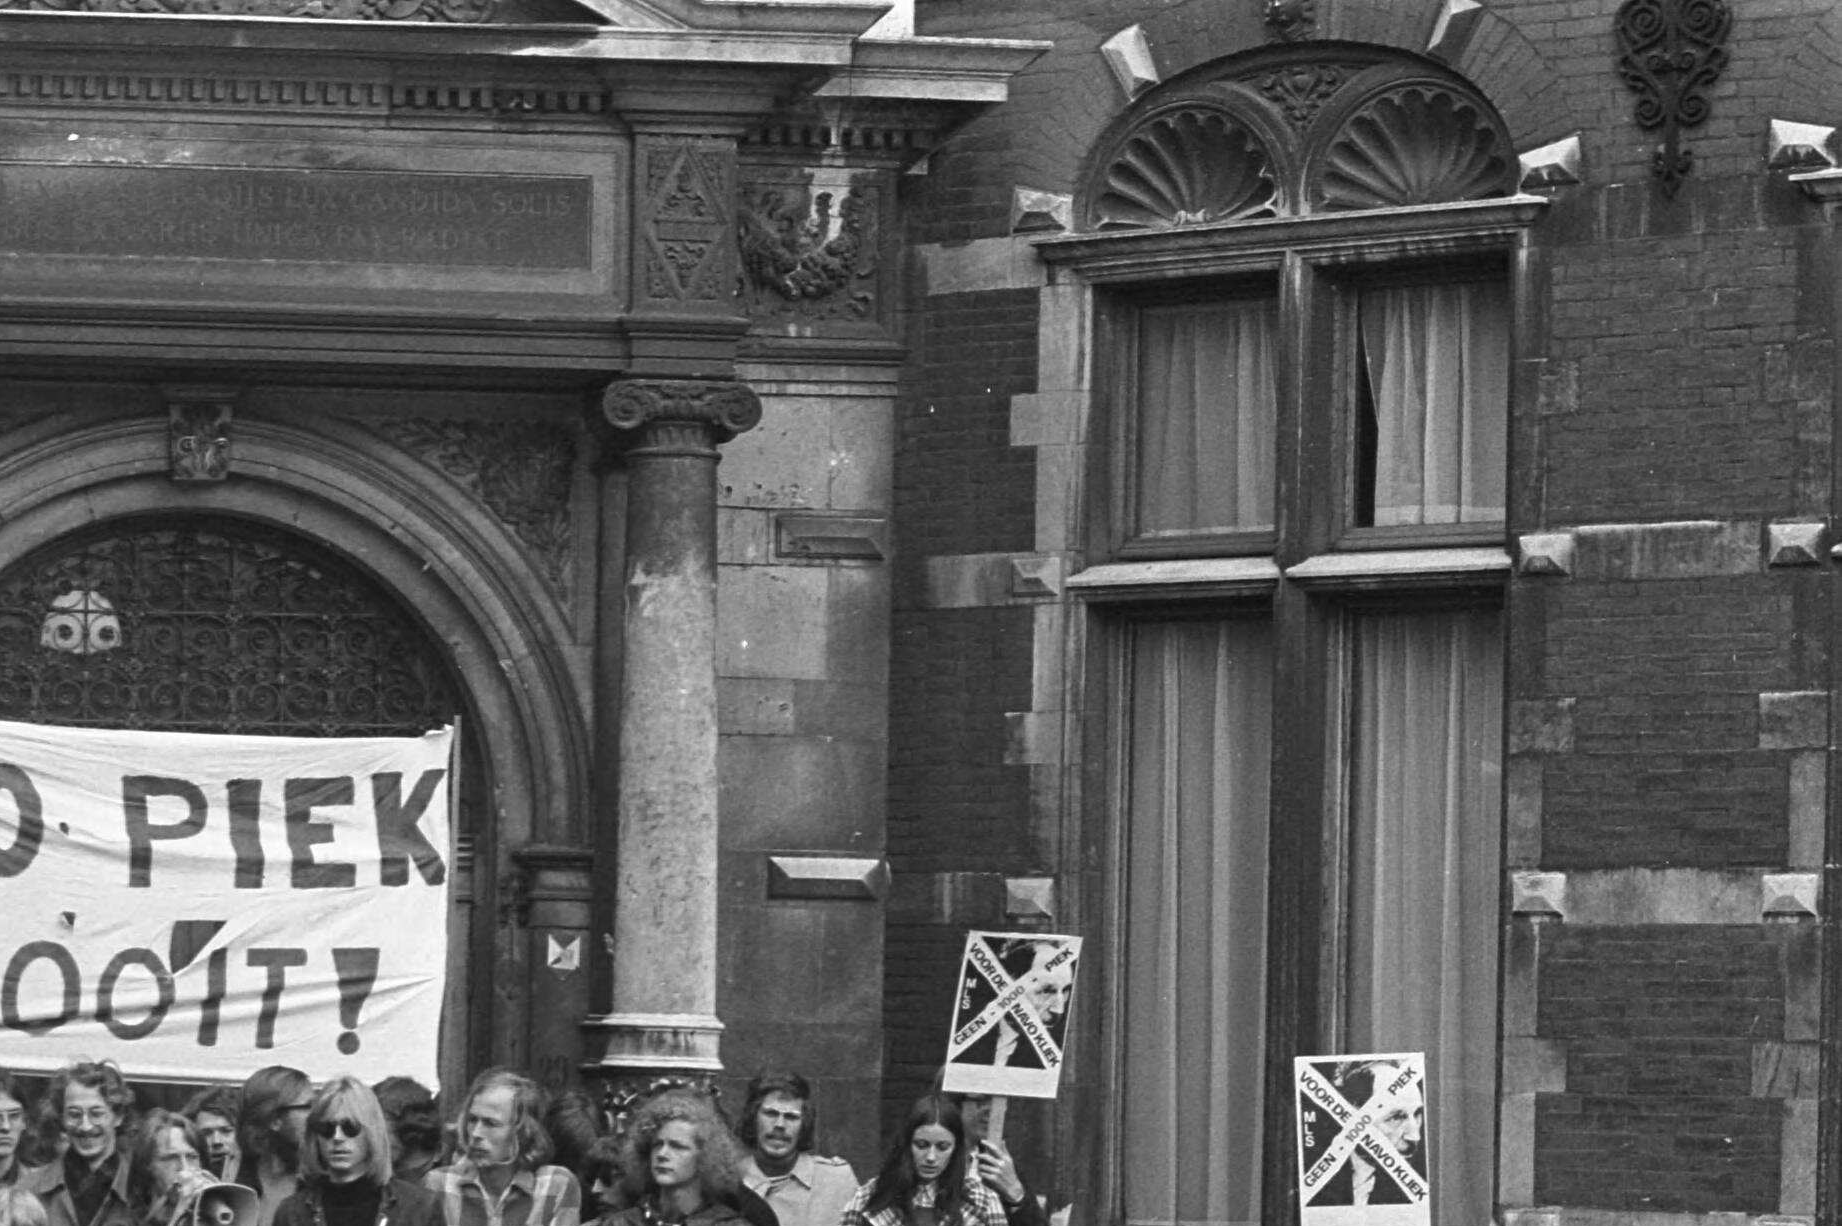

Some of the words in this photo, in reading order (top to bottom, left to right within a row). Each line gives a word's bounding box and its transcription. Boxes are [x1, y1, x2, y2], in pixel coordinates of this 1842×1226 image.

[490, 190, 572, 217] SOLIS
[121, 768, 447, 889] PIEK
[954, 1016, 987, 1045] GEEN
[1044, 948, 1074, 973] PIEK
[961, 978, 977, 1010] MLS
[969, 942, 996, 979] VOOR
[992, 973, 1009, 993] DE
[1011, 1003, 1038, 1036] NAVO
[1033, 1033, 1061, 1068] KLIEK
[1300, 1071, 1335, 1108] VOOR
[1332, 1103, 1353, 1124] DE
[1360, 1133, 1396, 1168] NAVO
[1393, 1165, 1428, 1202] KLIEK
[1303, 1152, 1337, 1188] GEEN
[1345, 1114, 1372, 1142] 1000
[1387, 1066, 1417, 1096] PIEK
[1303, 1111, 1317, 1148] MLS
